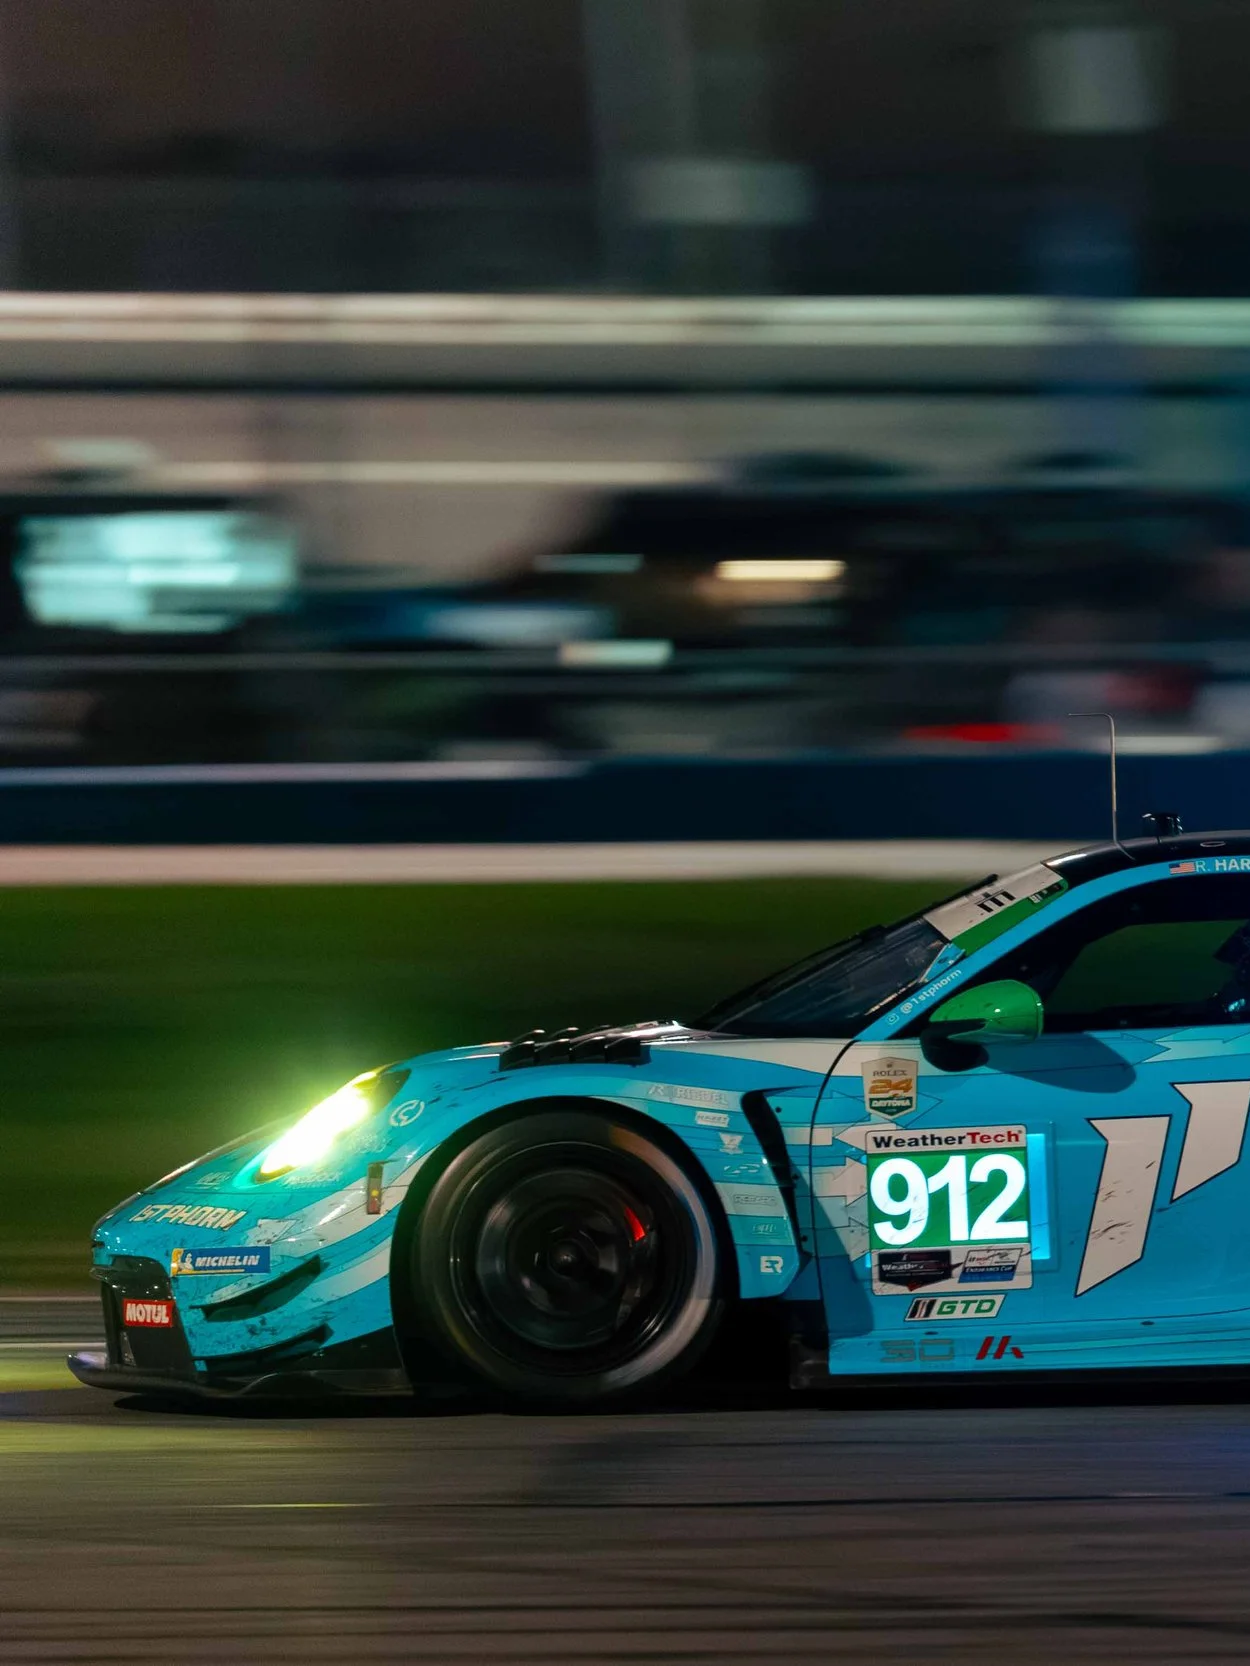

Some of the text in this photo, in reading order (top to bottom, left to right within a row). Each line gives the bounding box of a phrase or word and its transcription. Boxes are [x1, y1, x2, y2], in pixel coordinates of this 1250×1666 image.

[1195, 860, 1210, 872] R.
[872, 1069, 908, 1077] ROLEX
[868, 1078, 913, 1094] 24
[872, 1130, 1021, 1149] WeatherTech
[870, 1153, 1029, 1245] 912
[195, 1254, 261, 1267] MICHELIN
[126, 1303, 170, 1323] MOTUL
[936, 1299, 997, 1316] GTD
